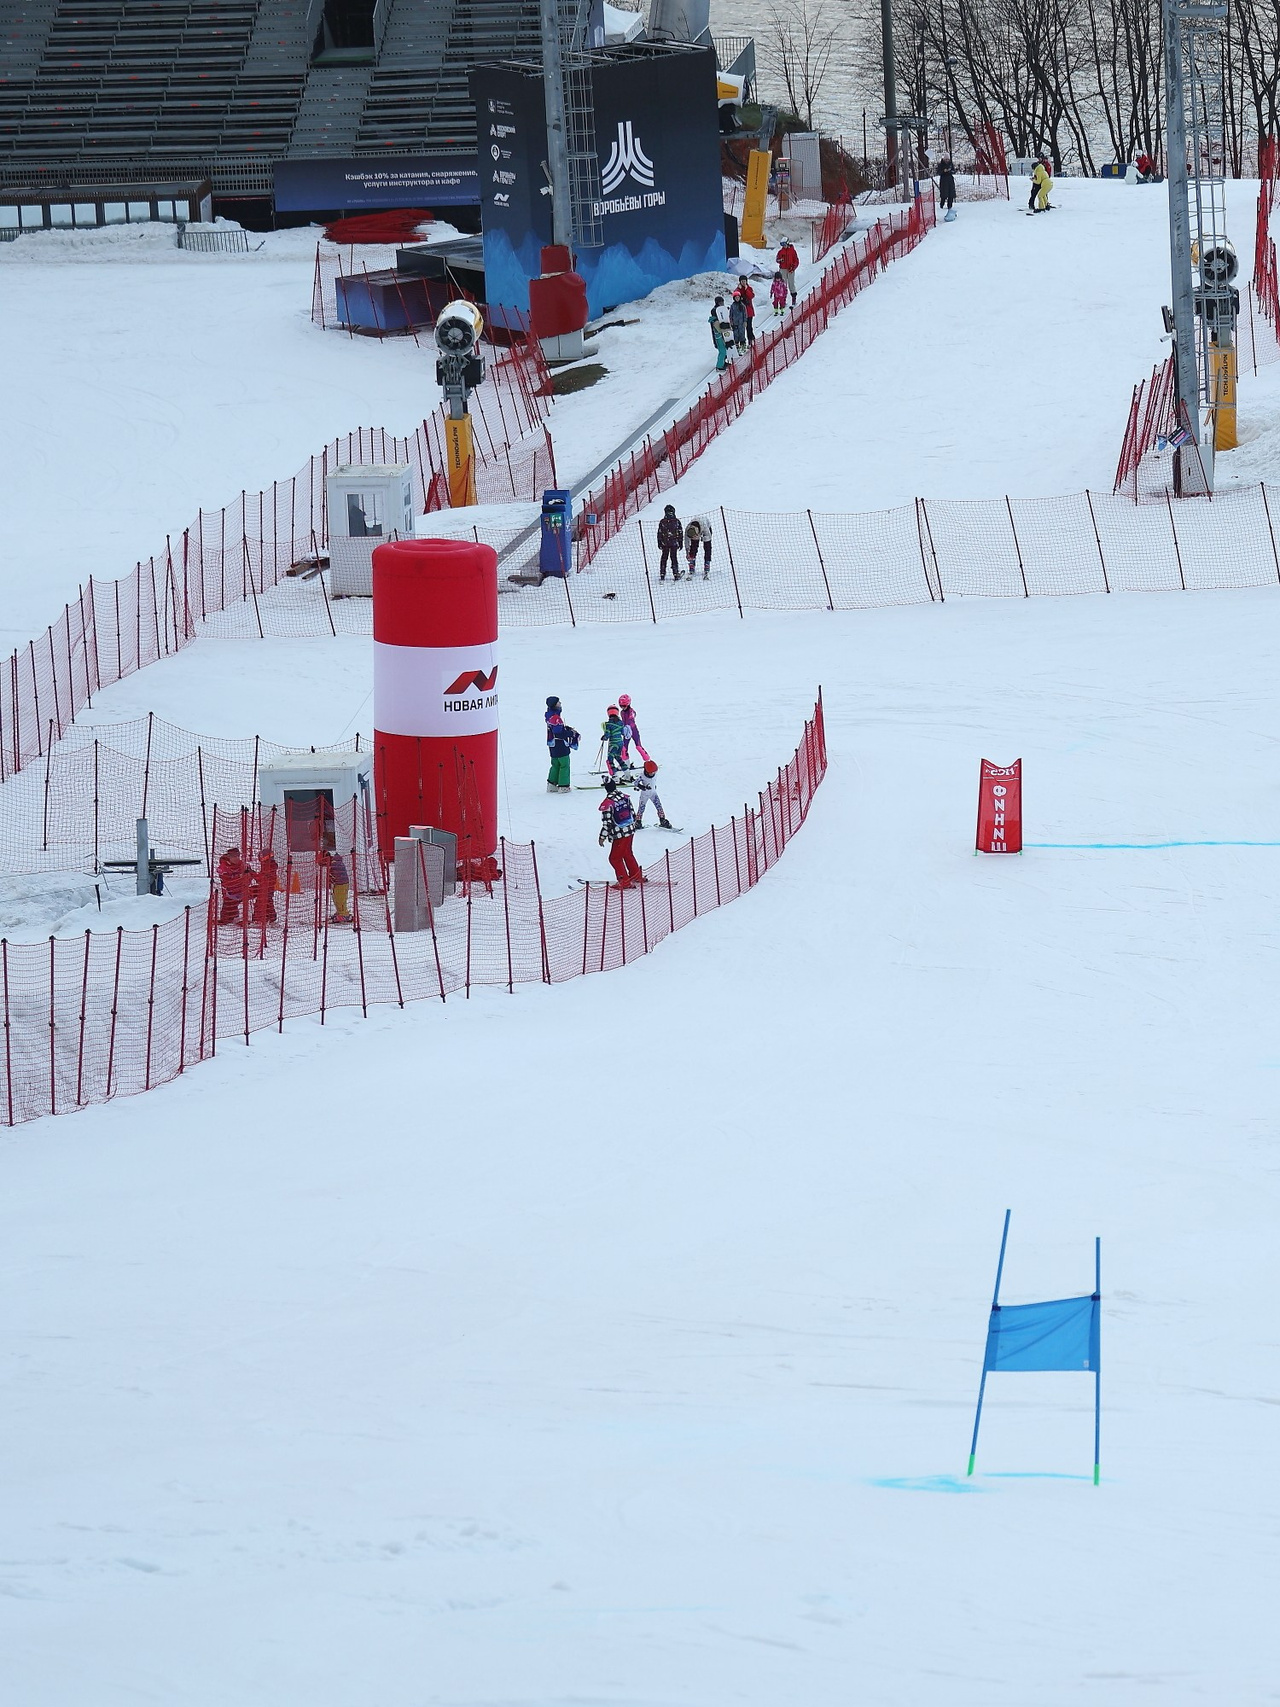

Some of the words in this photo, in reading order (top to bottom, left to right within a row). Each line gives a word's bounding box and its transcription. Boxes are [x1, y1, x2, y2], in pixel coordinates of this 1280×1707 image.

[345, 173, 373, 181] Кэшбэк
[431, 170, 478, 178] снаряжение,
[363, 180, 389, 189] услуги
[389, 179, 435, 187] инструктора
[593, 195, 642, 217] ВОРОБЬЁВЫ
[643, 190, 666, 208] ГОРЫ
[444, 698, 483, 712] НОВАЯ
